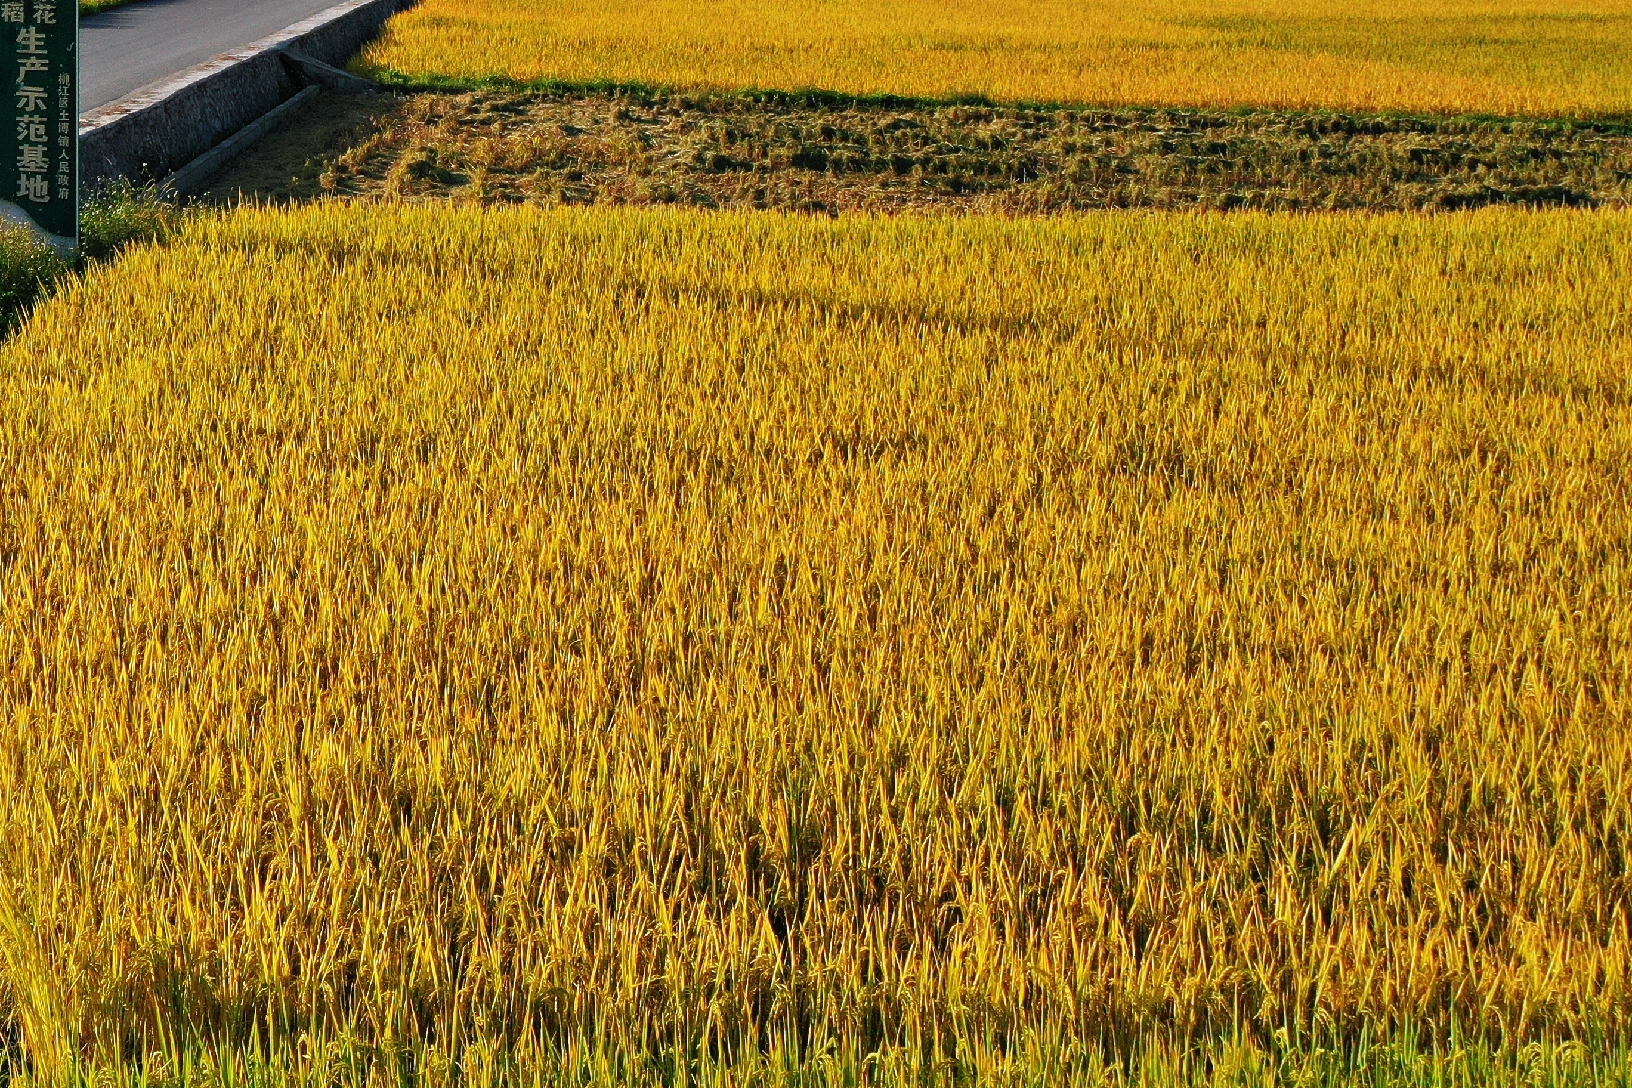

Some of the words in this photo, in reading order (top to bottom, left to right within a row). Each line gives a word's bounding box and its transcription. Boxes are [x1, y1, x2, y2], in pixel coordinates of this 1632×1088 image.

[16, 26, 50, 203] 生产示范基地
